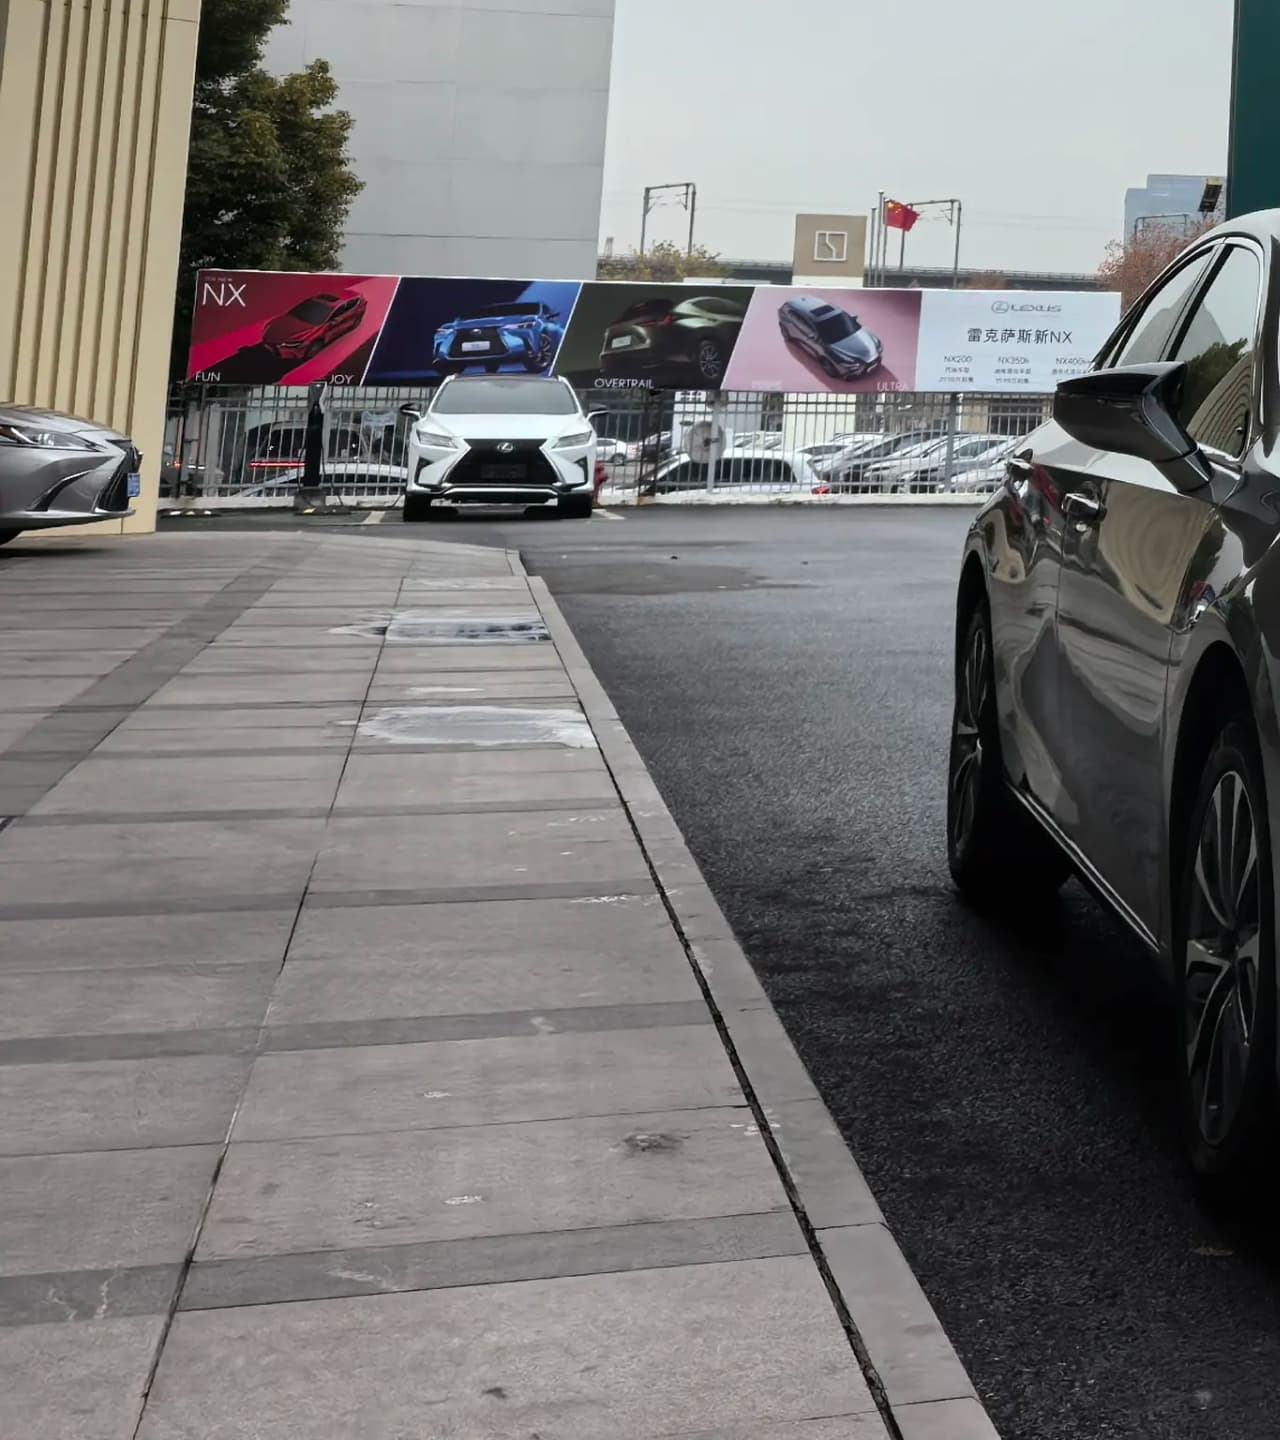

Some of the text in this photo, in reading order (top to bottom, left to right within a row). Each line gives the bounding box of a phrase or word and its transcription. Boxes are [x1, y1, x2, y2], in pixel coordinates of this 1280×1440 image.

[202, 282, 247, 307] NX
[1011, 303, 1062, 313] LEXUS
[967, 327, 1073, 345] 雷克萨斯新NX
[195, 372, 221, 382] FUN
[329, 374, 354, 384] JOY
[594, 378, 655, 389] OVERTRAIL
